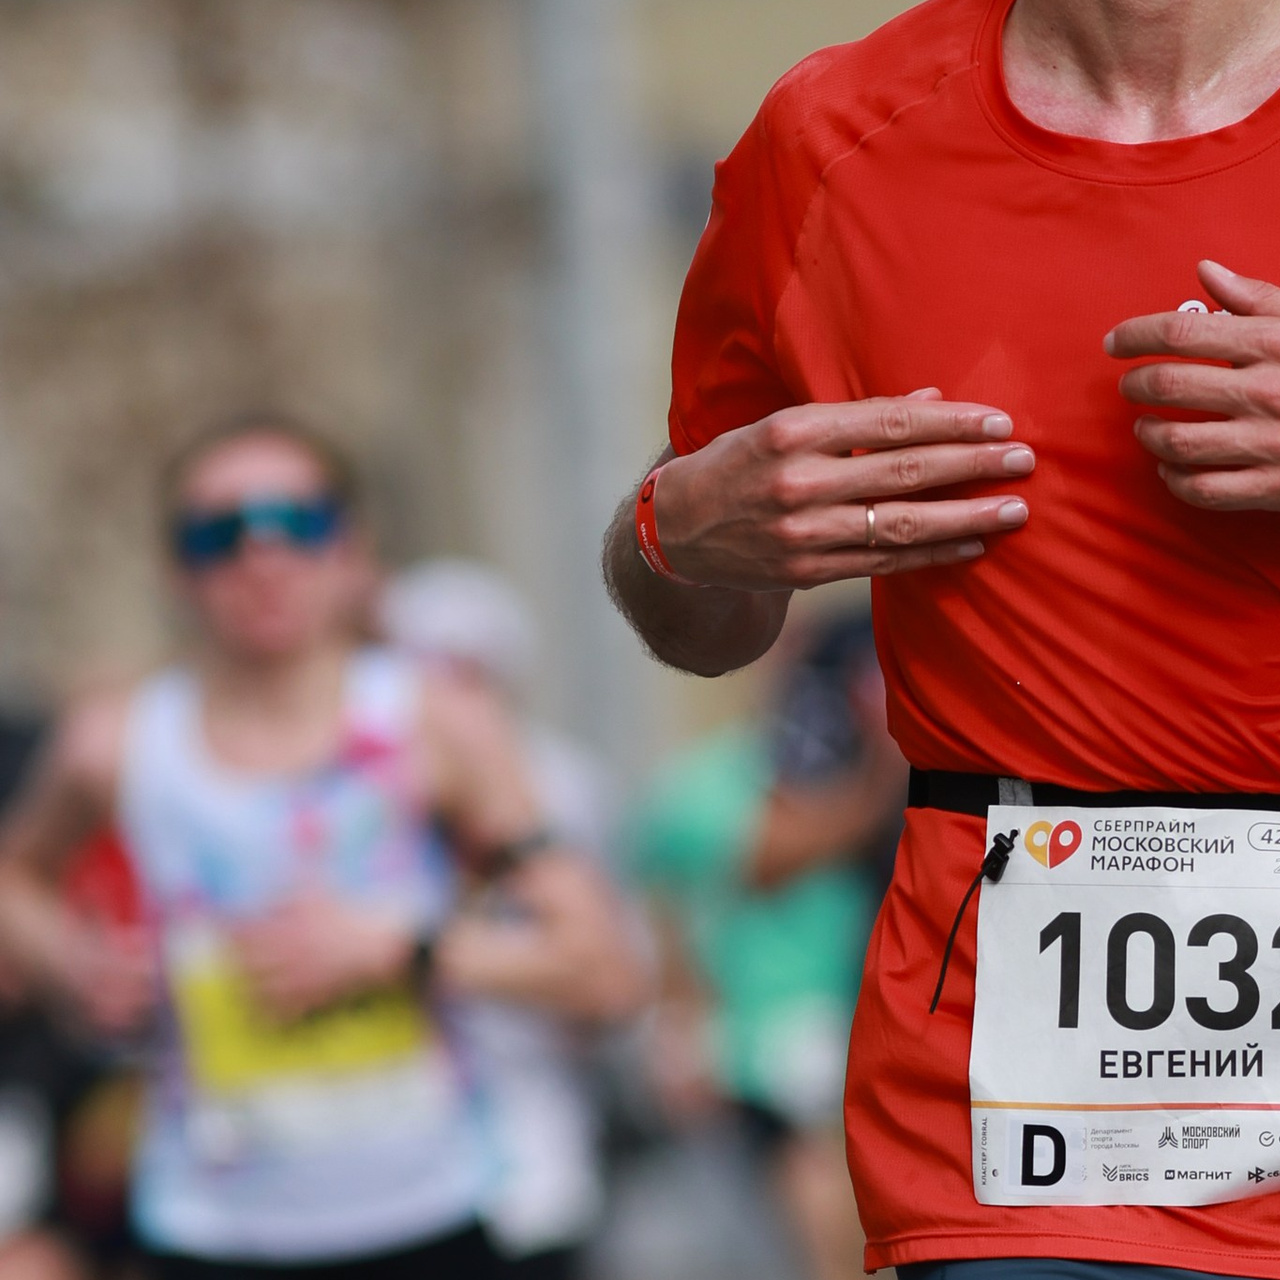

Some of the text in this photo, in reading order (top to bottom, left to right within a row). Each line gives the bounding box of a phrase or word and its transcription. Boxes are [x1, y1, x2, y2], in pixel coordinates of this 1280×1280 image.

[1093, 818, 1196, 834] СБЕРПРАЙМ
[1092, 835, 1235, 854] МОСКОВСКИЙ
[1090, 855, 1195, 872] МАРАФОН
[1099, 1042, 1263, 1078] ЕВГЕНИЙ
[1182, 1124, 1241, 1138] МОСКОВСКИЙ
[1182, 1138, 1209, 1150] СПОРТ
[1021, 1124, 1066, 1186] D
[1119, 1173, 1149, 1181] BRICS
